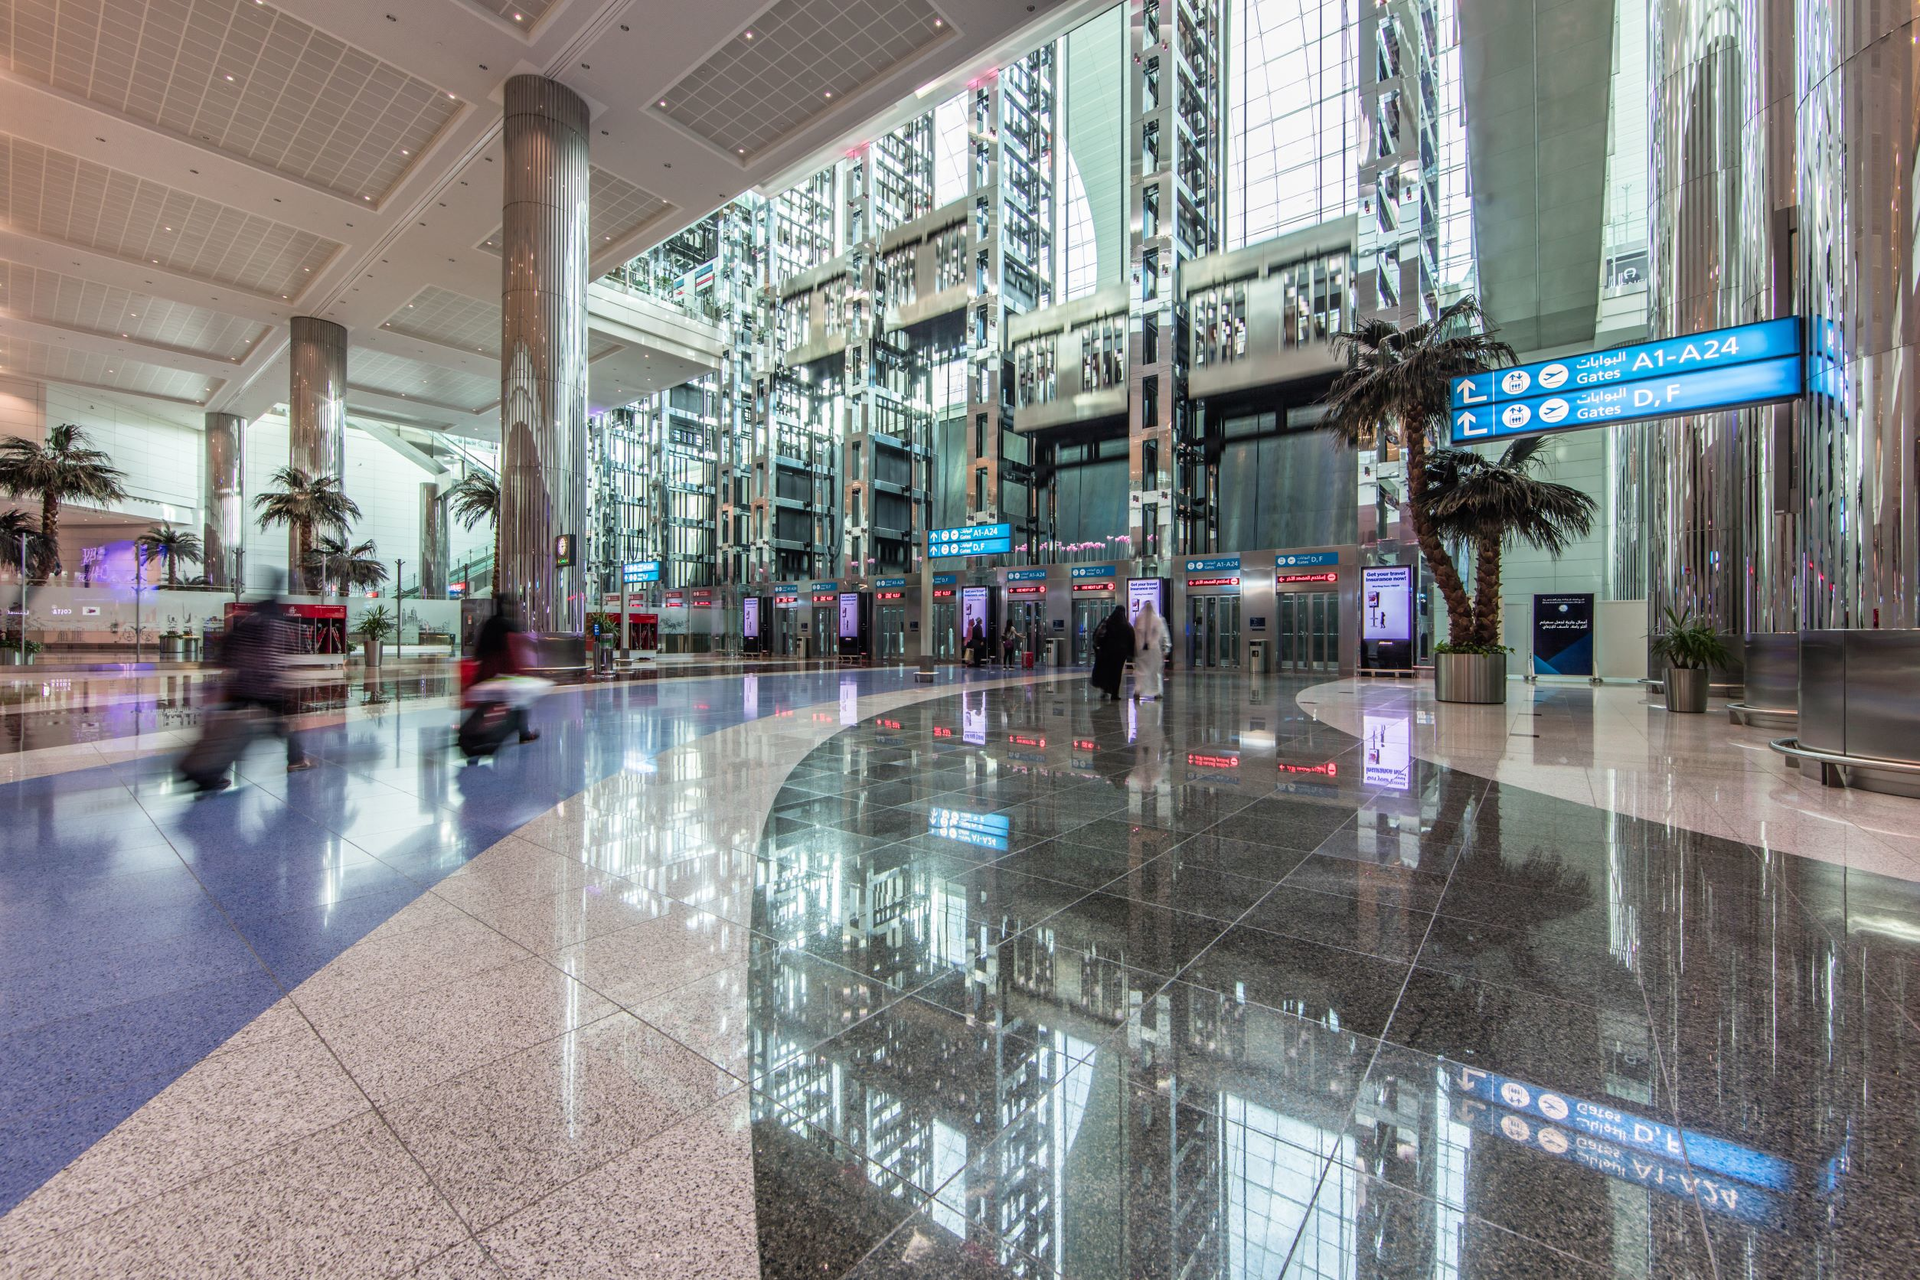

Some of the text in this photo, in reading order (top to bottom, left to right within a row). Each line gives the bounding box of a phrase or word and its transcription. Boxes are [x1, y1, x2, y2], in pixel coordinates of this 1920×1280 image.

[1577, 352, 1626, 369] البوابات
[1632, 336, 1739, 371] A1-A24
[1577, 368, 1621, 384] Gates
[1577, 388, 1626, 404] البوابات
[1577, 403, 1622, 420] Gates
[973, 527, 998, 536] A1-A24
